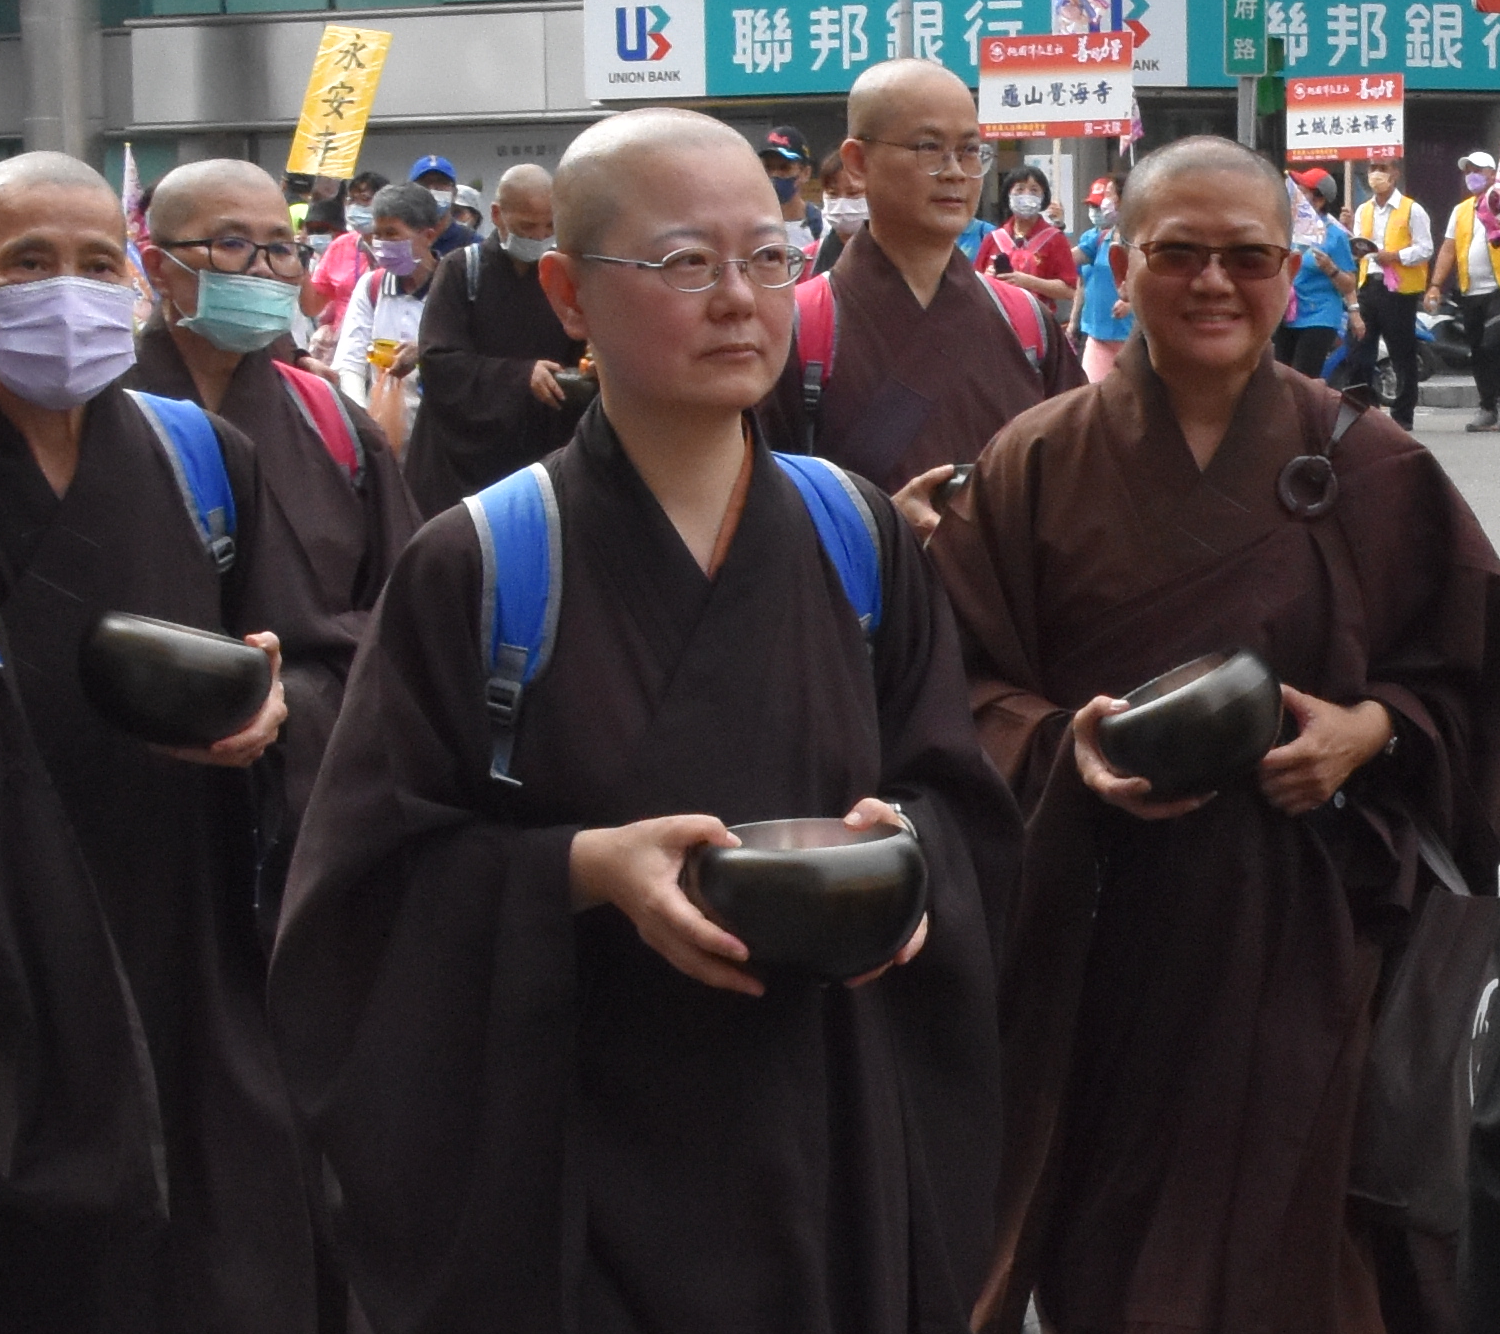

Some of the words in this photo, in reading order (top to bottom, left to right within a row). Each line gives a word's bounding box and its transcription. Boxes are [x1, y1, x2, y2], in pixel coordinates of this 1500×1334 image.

[1133, 60, 1160, 71] ANK
[608, 72, 647, 85] UNION
[648, 70, 681, 83] BANK
[308, 33, 371, 160] 永安寺
[1001, 79, 1113, 108] 龜山覺海寺
